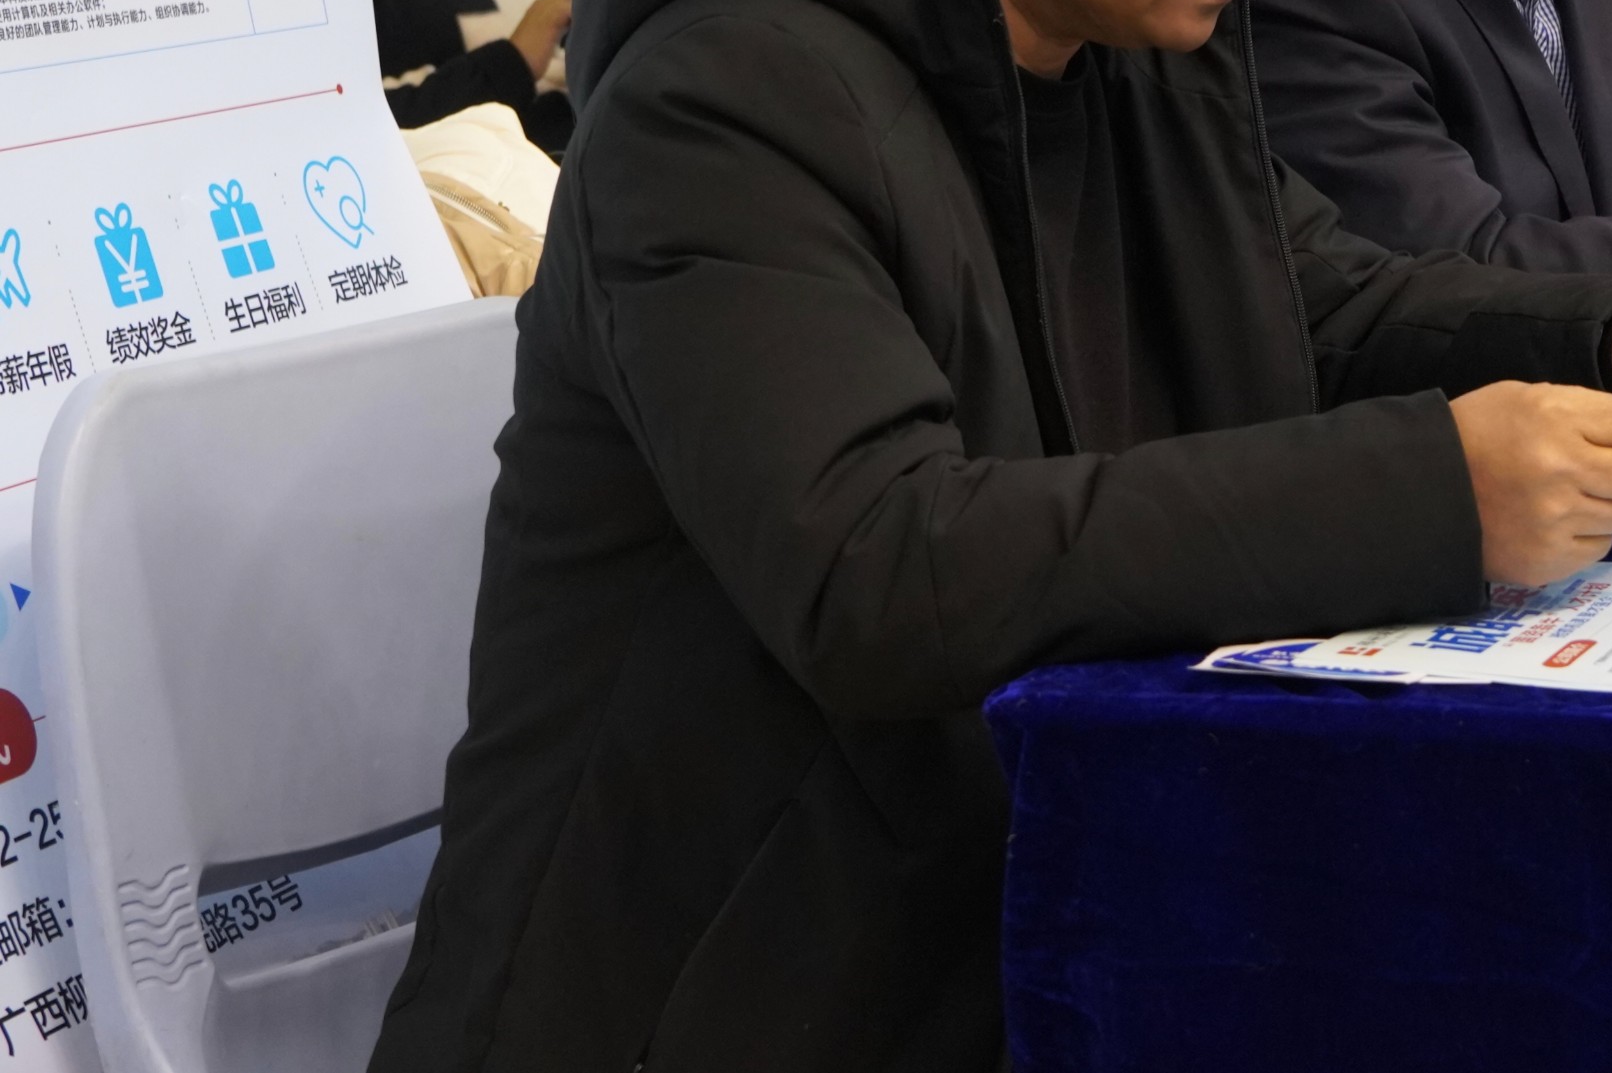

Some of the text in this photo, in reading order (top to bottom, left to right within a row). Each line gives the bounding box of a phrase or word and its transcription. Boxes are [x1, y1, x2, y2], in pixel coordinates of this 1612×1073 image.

[328, 254, 408, 305] 定期体检
[224, 281, 307, 335] 生日福利
[106, 310, 196, 365] 绩效奖金
[0, 896, 74, 966] 邮箱：
